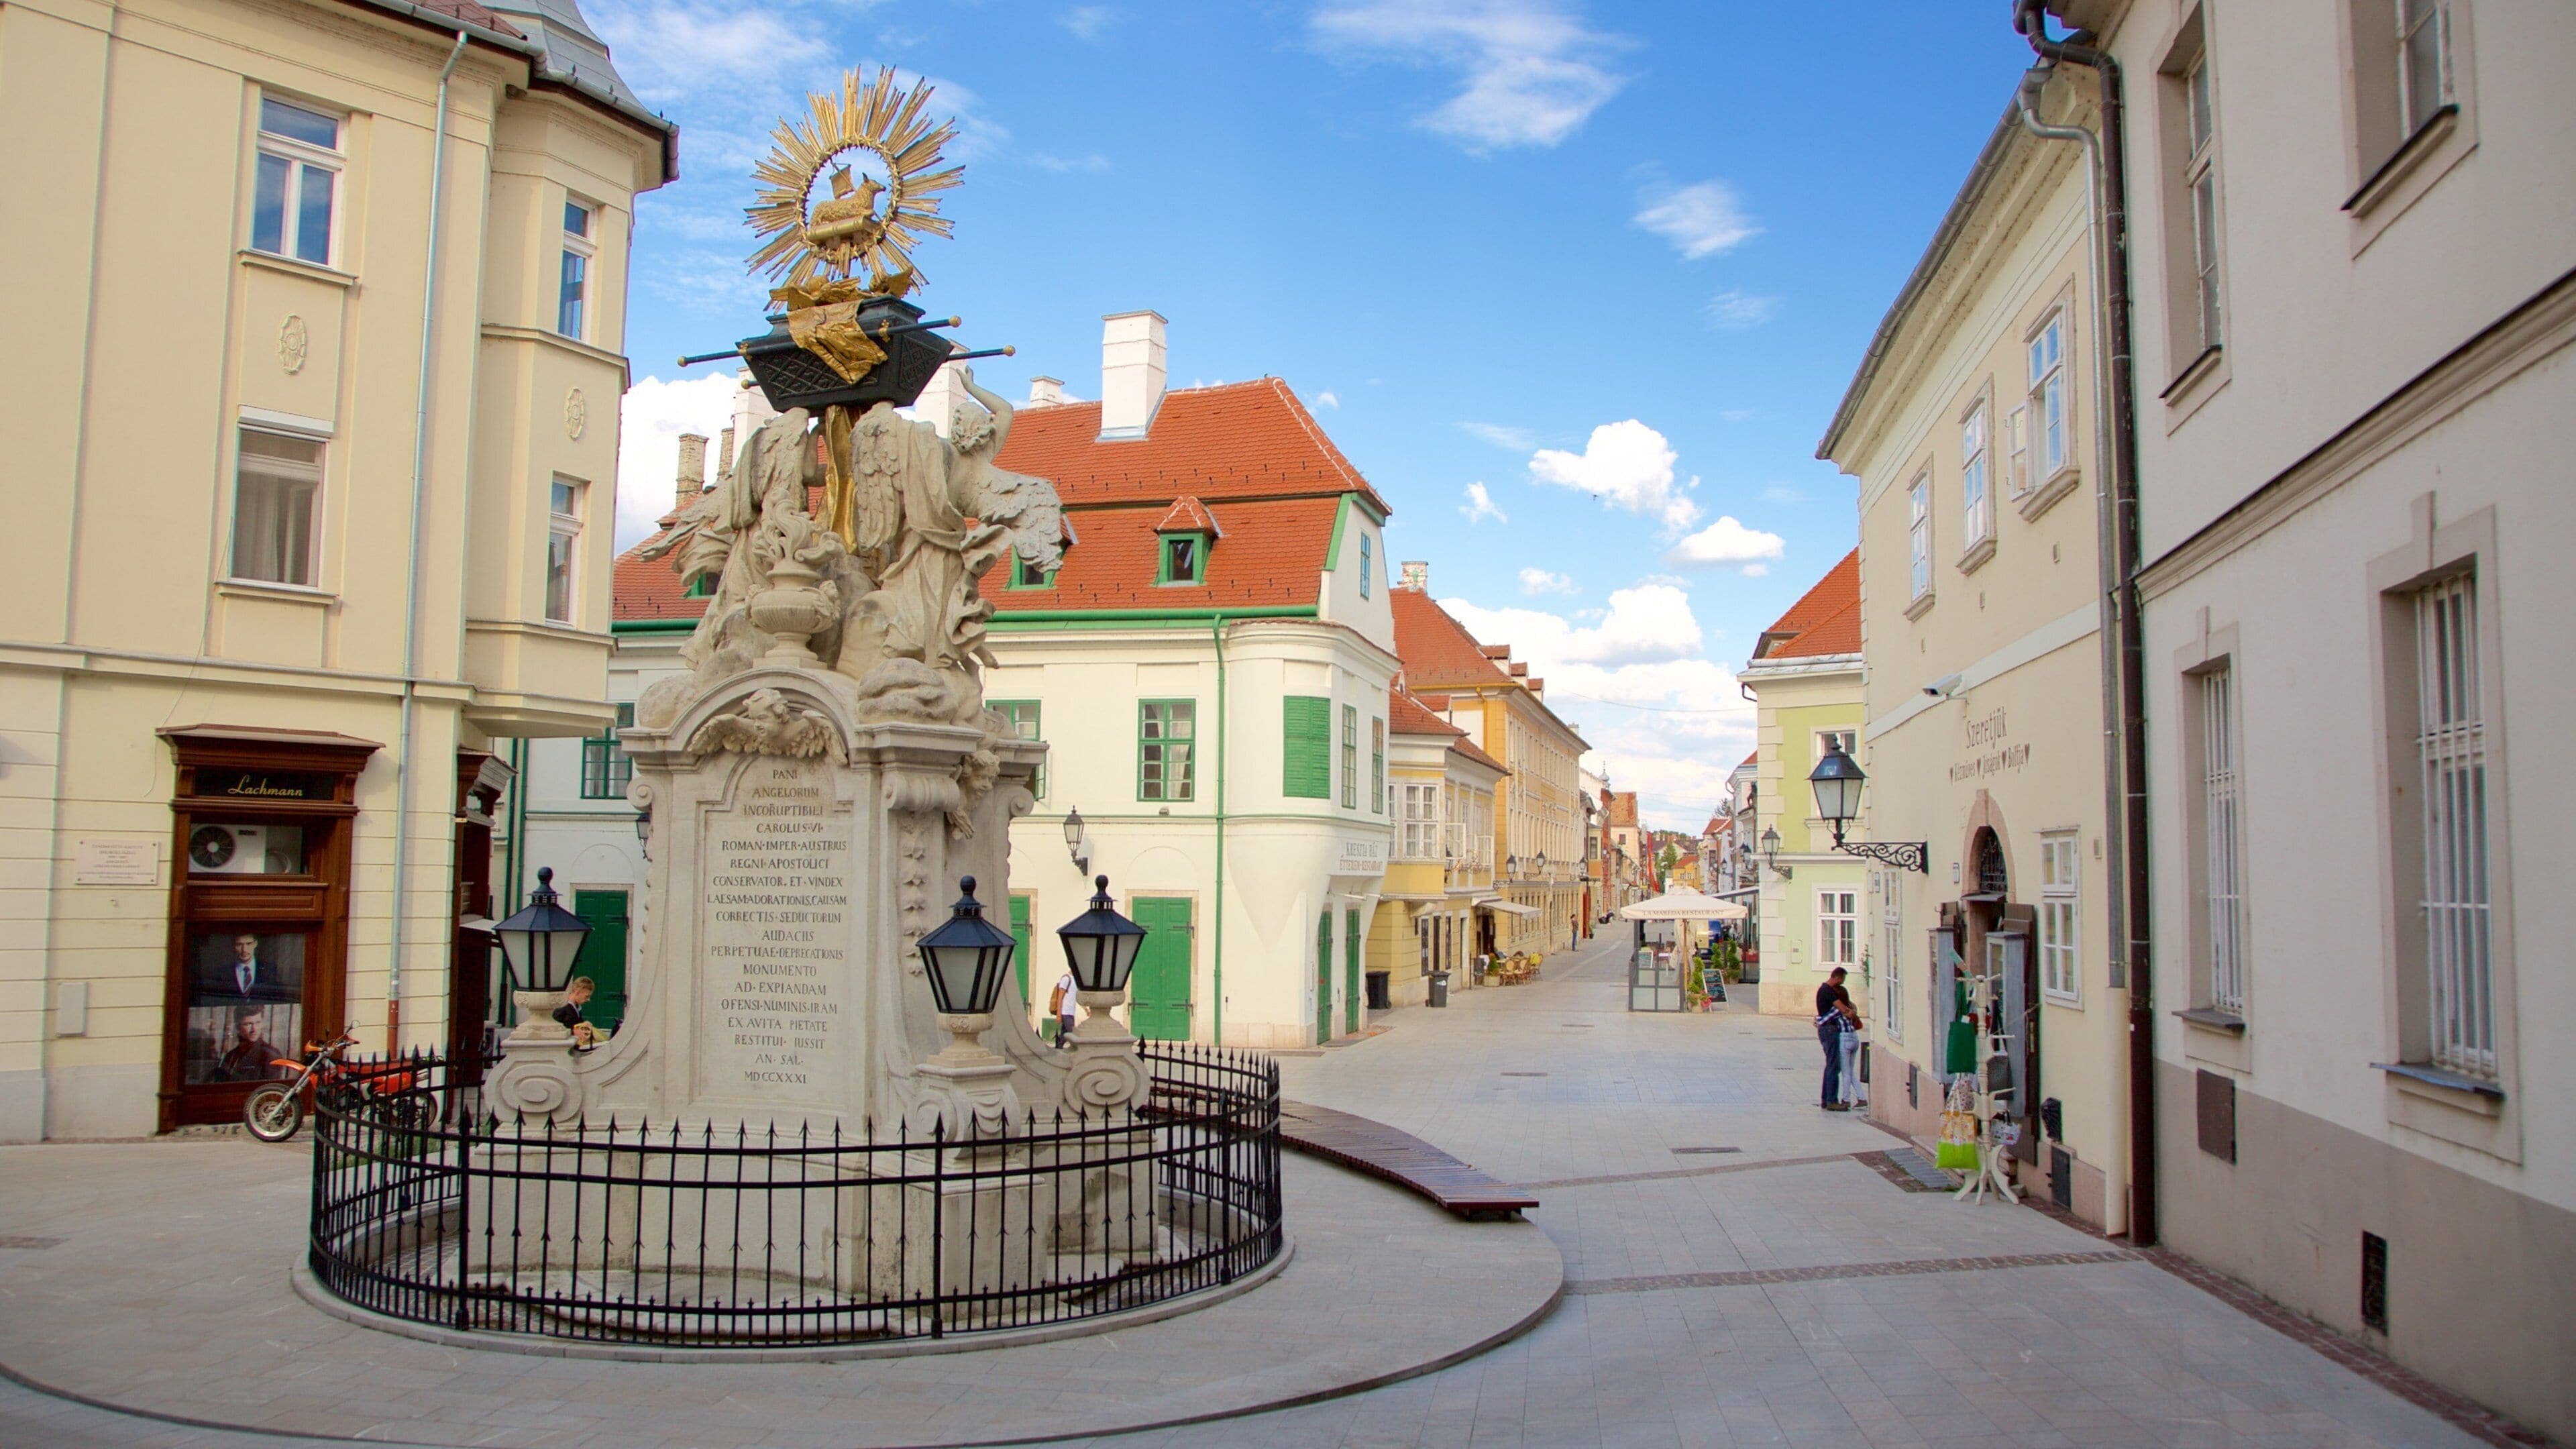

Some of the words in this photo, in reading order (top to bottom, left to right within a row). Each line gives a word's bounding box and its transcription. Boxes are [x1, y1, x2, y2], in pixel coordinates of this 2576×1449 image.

[1966, 706, 2007, 749] Szeretjük
[773, 769, 798, 780] PANI
[228, 774, 303, 796] Lachmann
[751, 787, 819, 798] ANGELORUM
[808, 876, 843, 888] VINDEX
[780, 912, 841, 924] SEDUCTORUM
[762, 930, 814, 942] AUDACIIS
[743, 963, 816, 977] MONUMENTO
[759, 982, 826, 996] EXPIANDAM
[810, 1002, 837, 1014] IRAM
[728, 1017, 743, 1028] EX
[746, 1018, 782, 1030] AVITA
[790, 1020, 826, 1032] PIETATE
[794, 1037, 826, 1049] IUSSIT
[744, 1071, 806, 1084] MDCCXXXI
